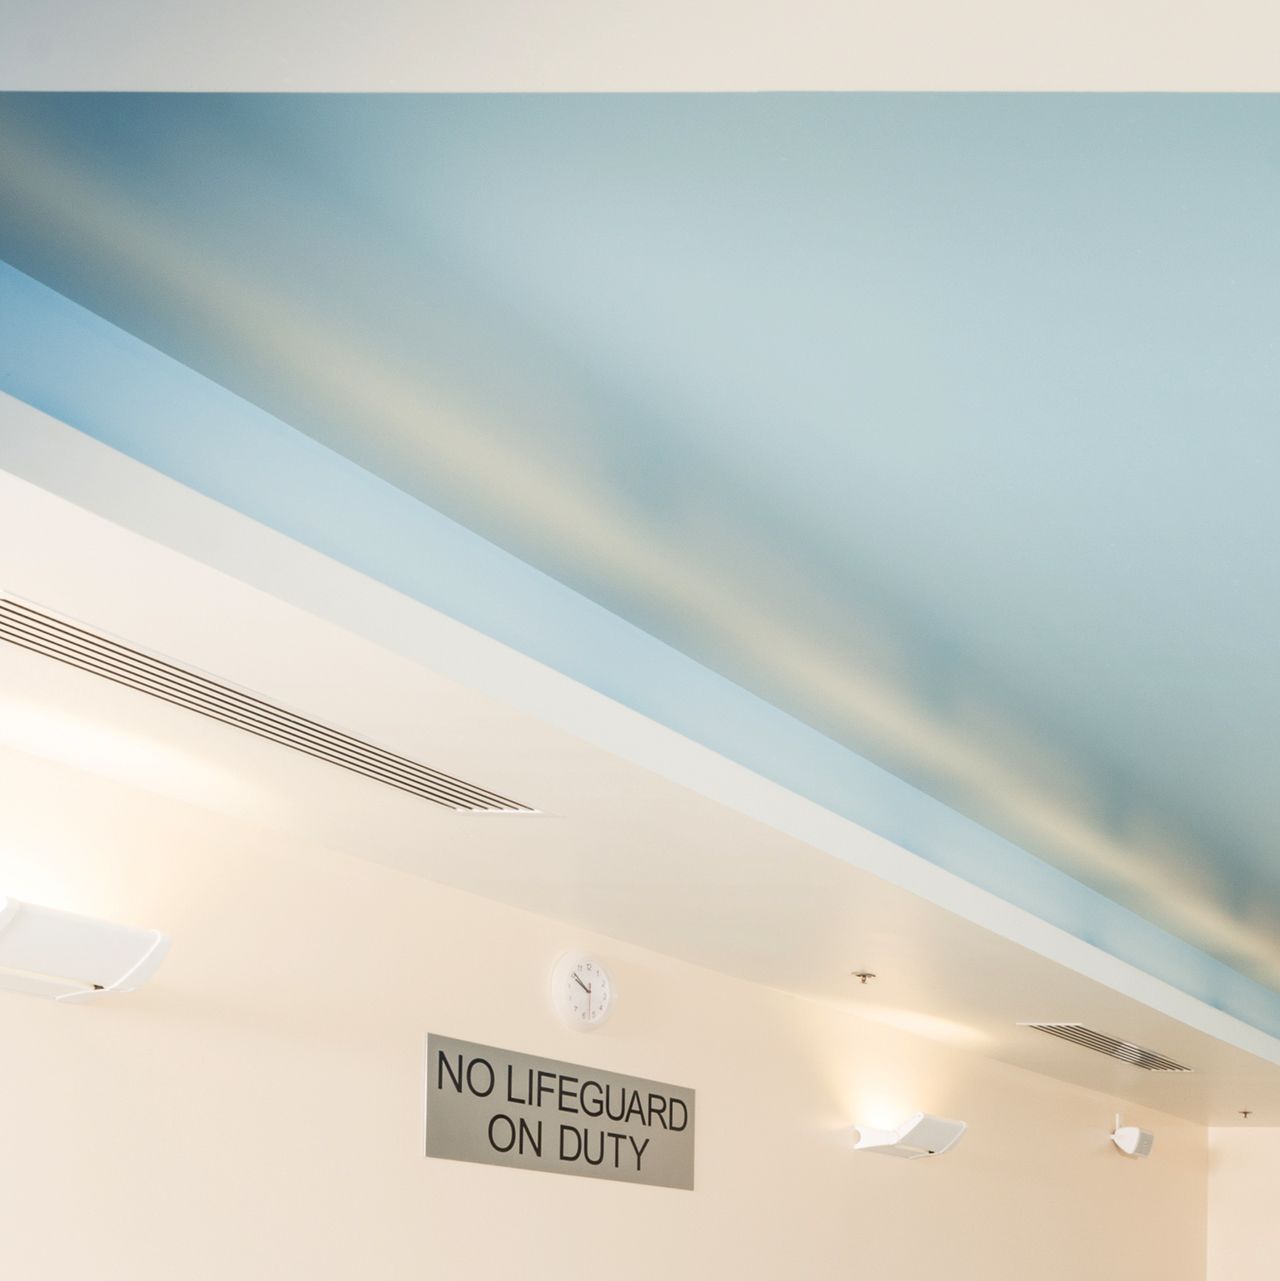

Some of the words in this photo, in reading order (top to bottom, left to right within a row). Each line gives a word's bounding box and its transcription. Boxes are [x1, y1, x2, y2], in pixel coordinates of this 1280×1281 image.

[437, 1049, 496, 1098] NO
[506, 1064, 689, 1132] LIFEGUARD
[487, 1113, 543, 1158] ON
[558, 1124, 650, 1172] DUTY
